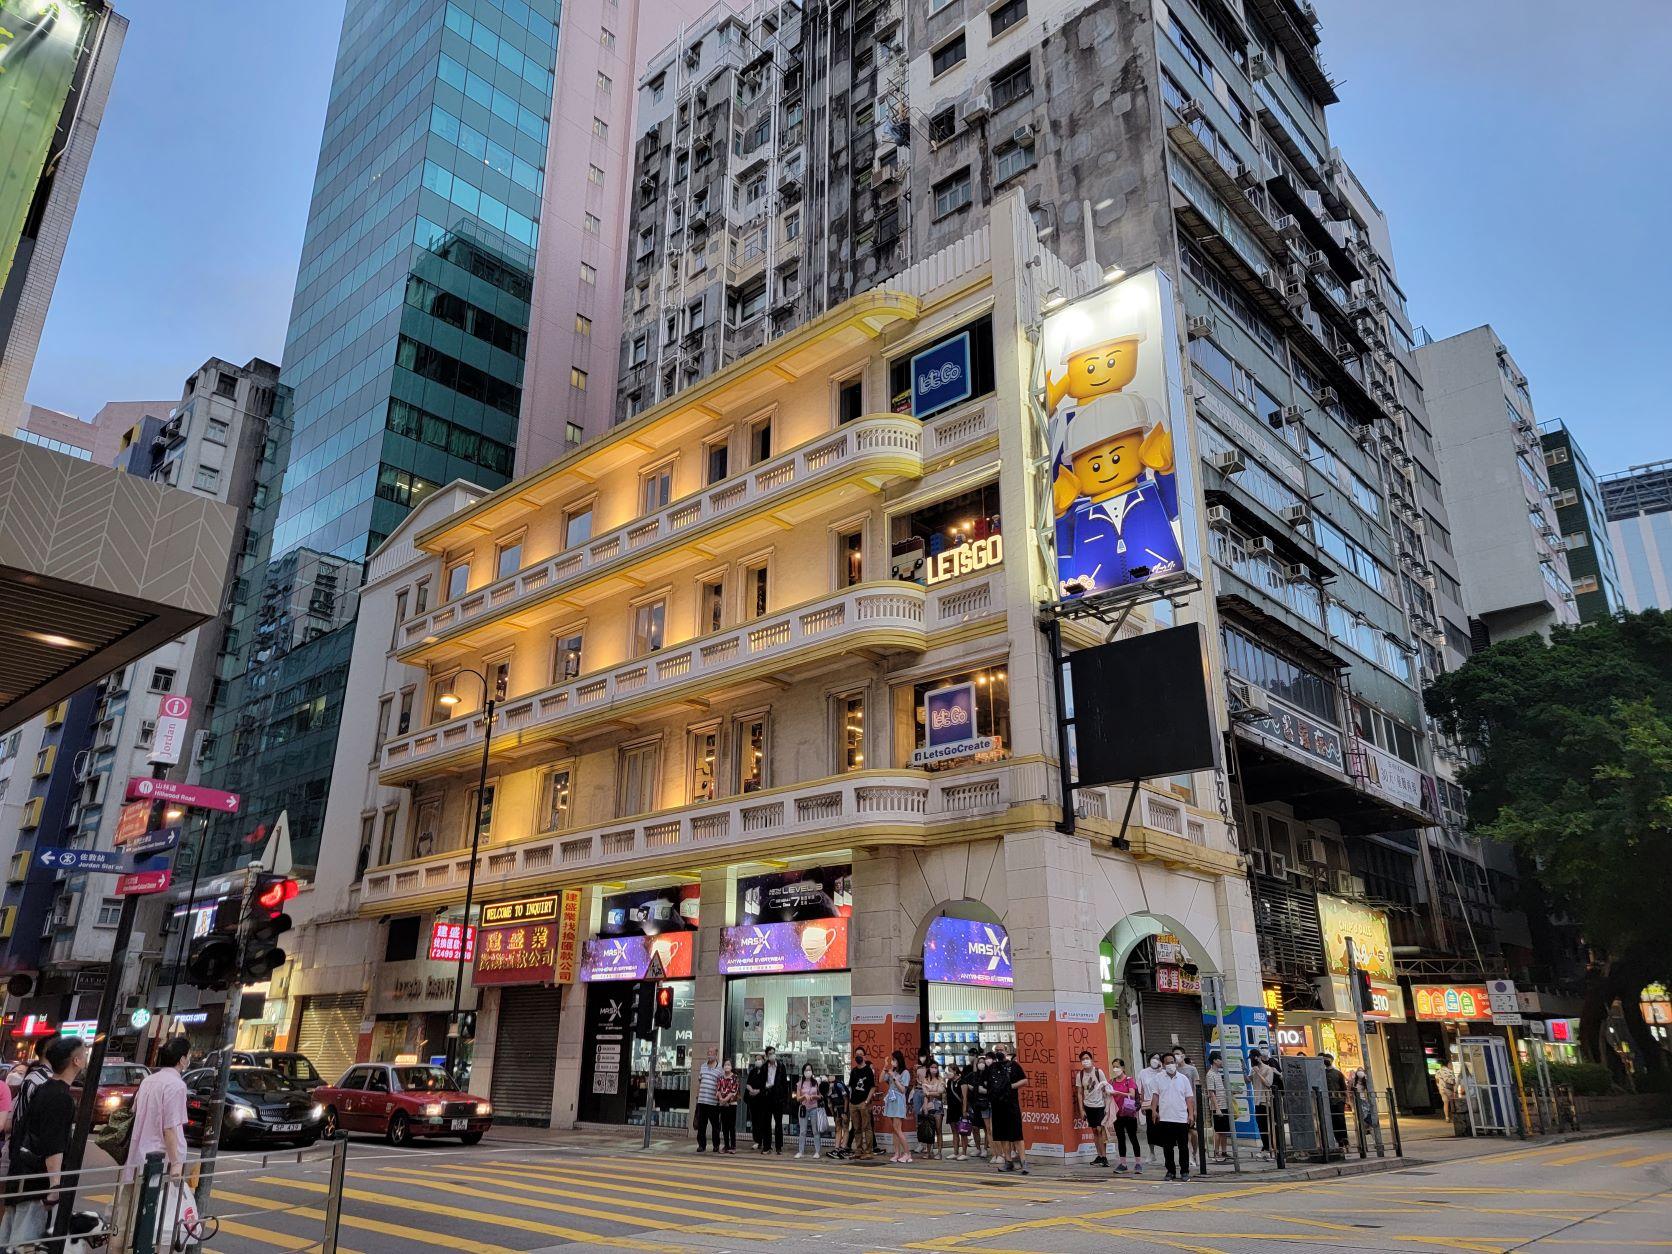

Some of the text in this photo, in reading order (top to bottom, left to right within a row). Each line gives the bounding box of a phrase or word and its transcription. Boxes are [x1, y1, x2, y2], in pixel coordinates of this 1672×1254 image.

[161, 723, 176, 758] Jordan
[923, 740, 991, 760] LetsGoCreate
[180, 794, 196, 802] Road
[80, 853, 106, 862] 佐敦站
[782, 886, 814, 894] LEVEL
[486, 900, 554, 921] WELCOME TO INQUIRY
[485, 926, 549, 952] 建盛業
[852, 1029, 876, 1044] FOR
[894, 1032, 912, 1046] FOR
[1017, 1032, 1044, 1047] FOR
[1067, 1027, 1089, 1044] FOR
[1019, 1048, 1056, 1064] LEASE
[1021, 1090, 1049, 1109] 招租
[1022, 1112, 1060, 1124] 2529 2936
